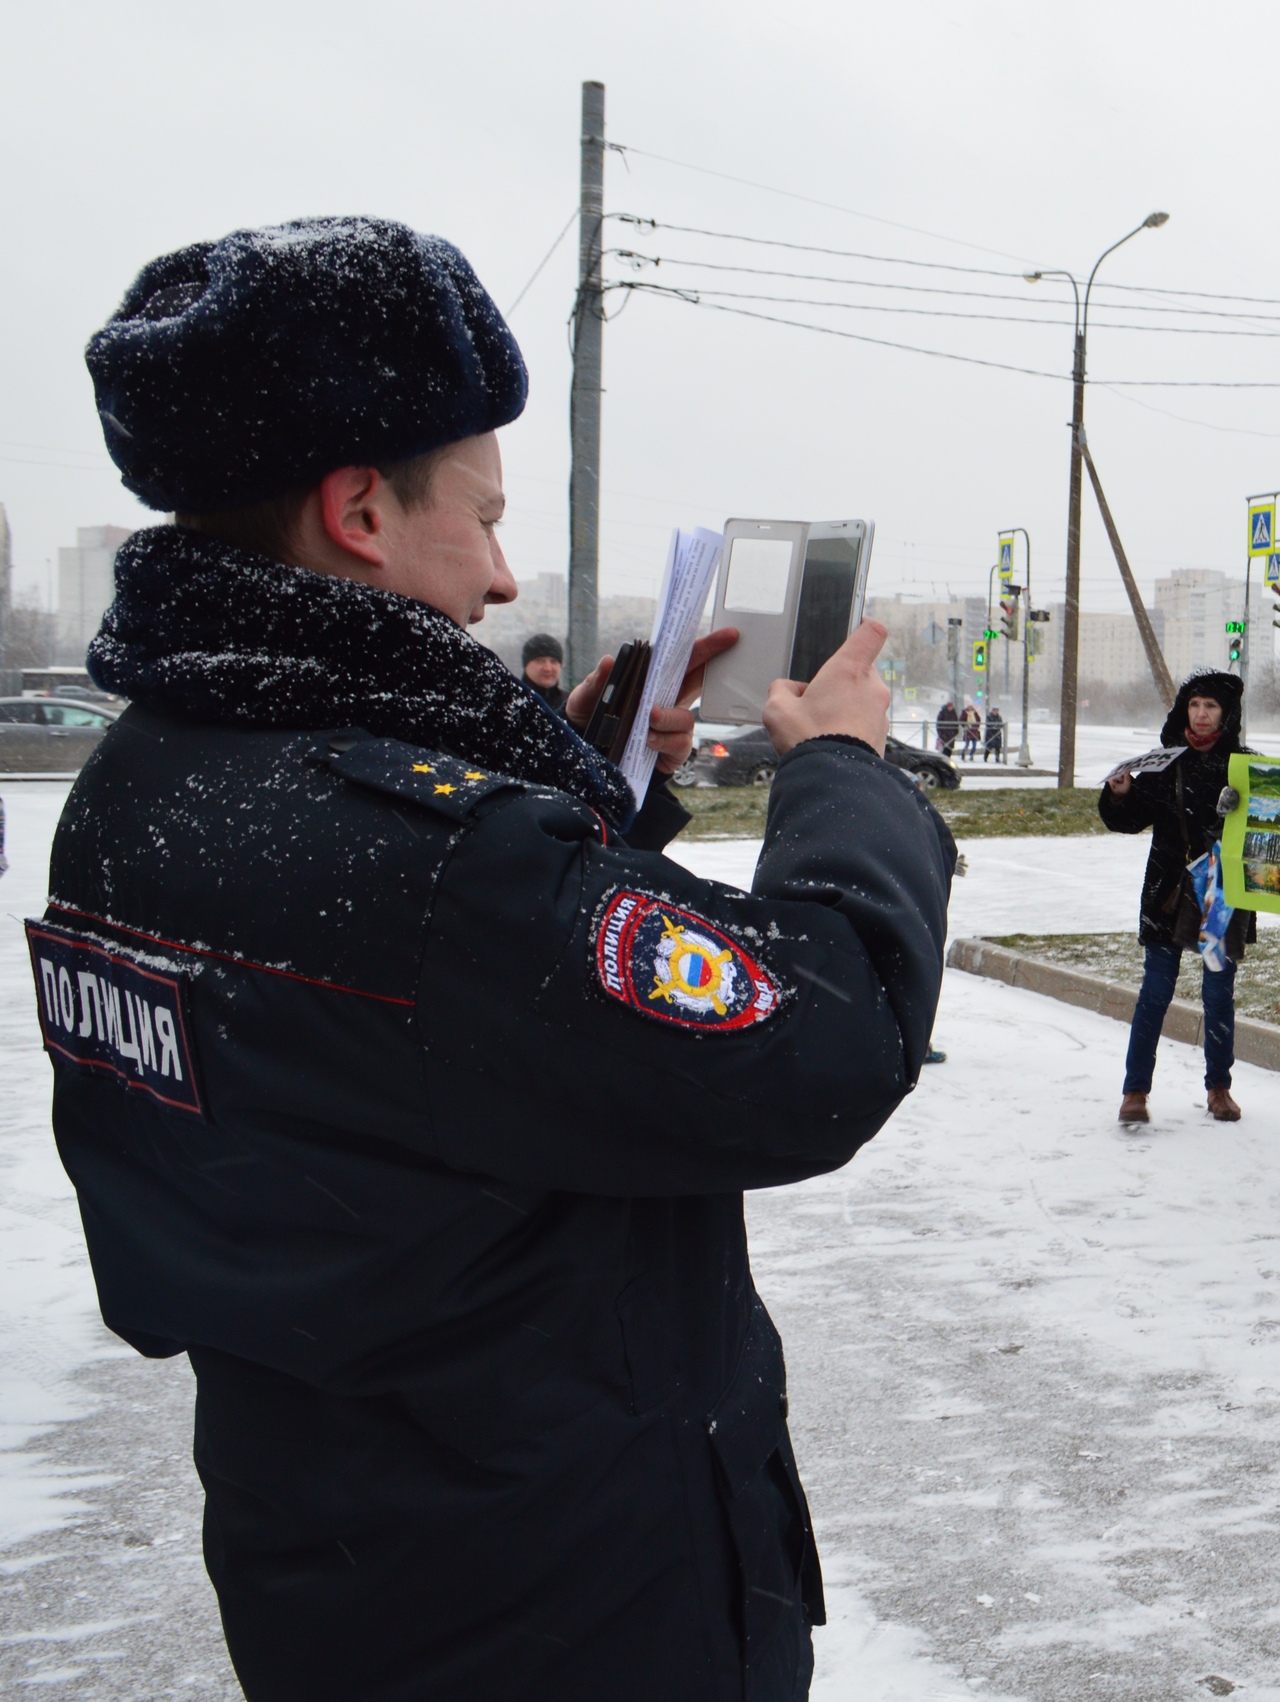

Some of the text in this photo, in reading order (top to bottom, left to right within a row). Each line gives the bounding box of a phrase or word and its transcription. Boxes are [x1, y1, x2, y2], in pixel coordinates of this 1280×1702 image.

[603, 898, 637, 991] ПОЛИЦИЯ
[40, 957, 183, 1081] ПОЛИЦИЯ
[753, 979, 775, 1011] МВД
